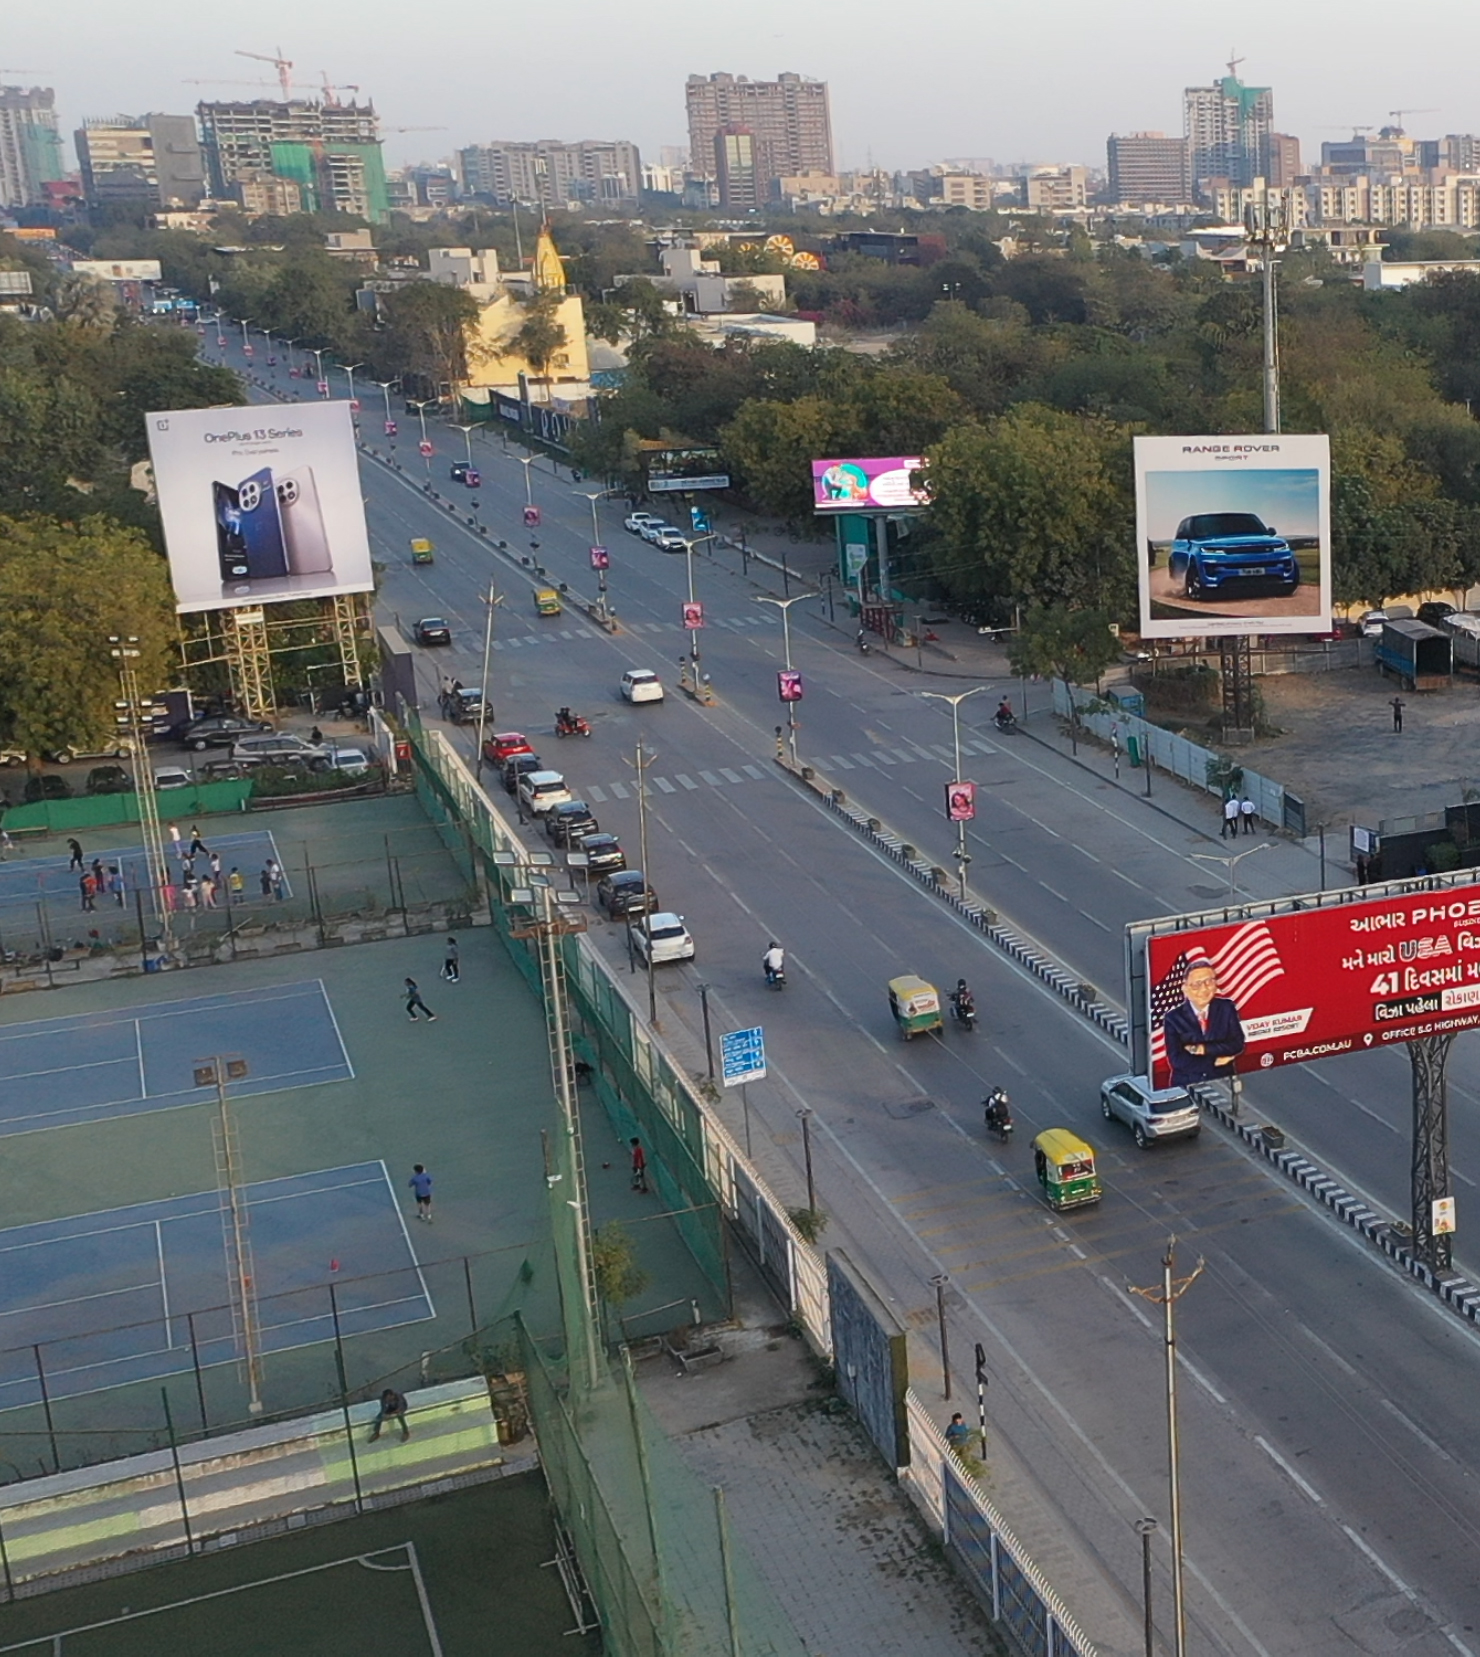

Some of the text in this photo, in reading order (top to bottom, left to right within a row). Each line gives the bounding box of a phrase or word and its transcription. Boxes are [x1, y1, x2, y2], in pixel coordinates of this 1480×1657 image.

[204, 431, 251, 443] OnePlus
[253, 429, 266, 440] 13
[267, 427, 303, 439] Series
[1182, 445, 1280, 454] RANGE ROVER
[1350, 912, 1405, 932] આભાર
[1342, 948, 1365, 970] મને
[1367, 944, 1396, 966] મારો
[1399, 935, 1453, 962] USA
[1370, 971, 1399, 995] 41
[1404, 959, 1463, 991] દિવસમાં
[1375, 1003, 1403, 1020] વિઝા
[1405, 997, 1439, 1015] પહેલા
[1445, 990, 1480, 1006] રોકાણ
[1382, 1026, 1416, 1040] OFFICE
[1434, 1015, 1480, 1031] HIGHWAY,
